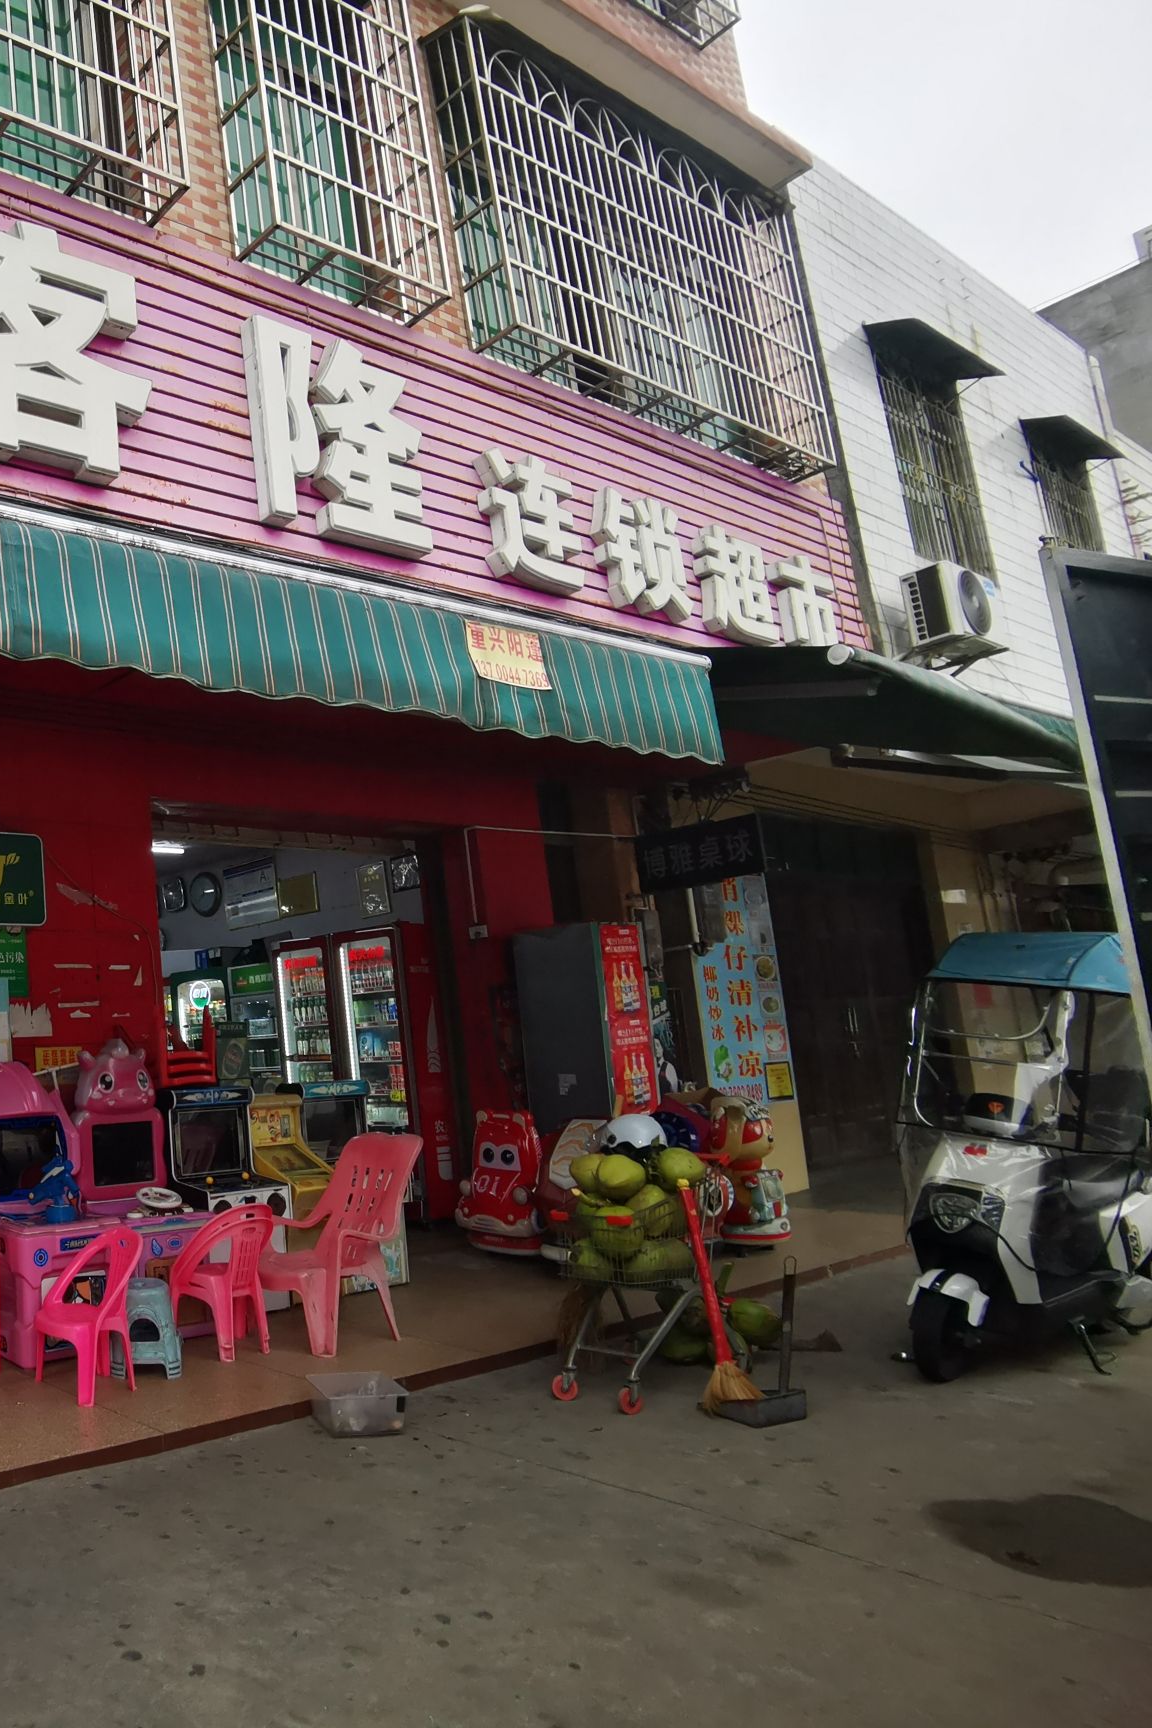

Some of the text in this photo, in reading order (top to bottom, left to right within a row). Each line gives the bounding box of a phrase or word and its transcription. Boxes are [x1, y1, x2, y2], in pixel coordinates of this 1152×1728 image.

[471, 447, 838, 647] 连锁超市
[643, 828, 754, 879] 博雅桌球
